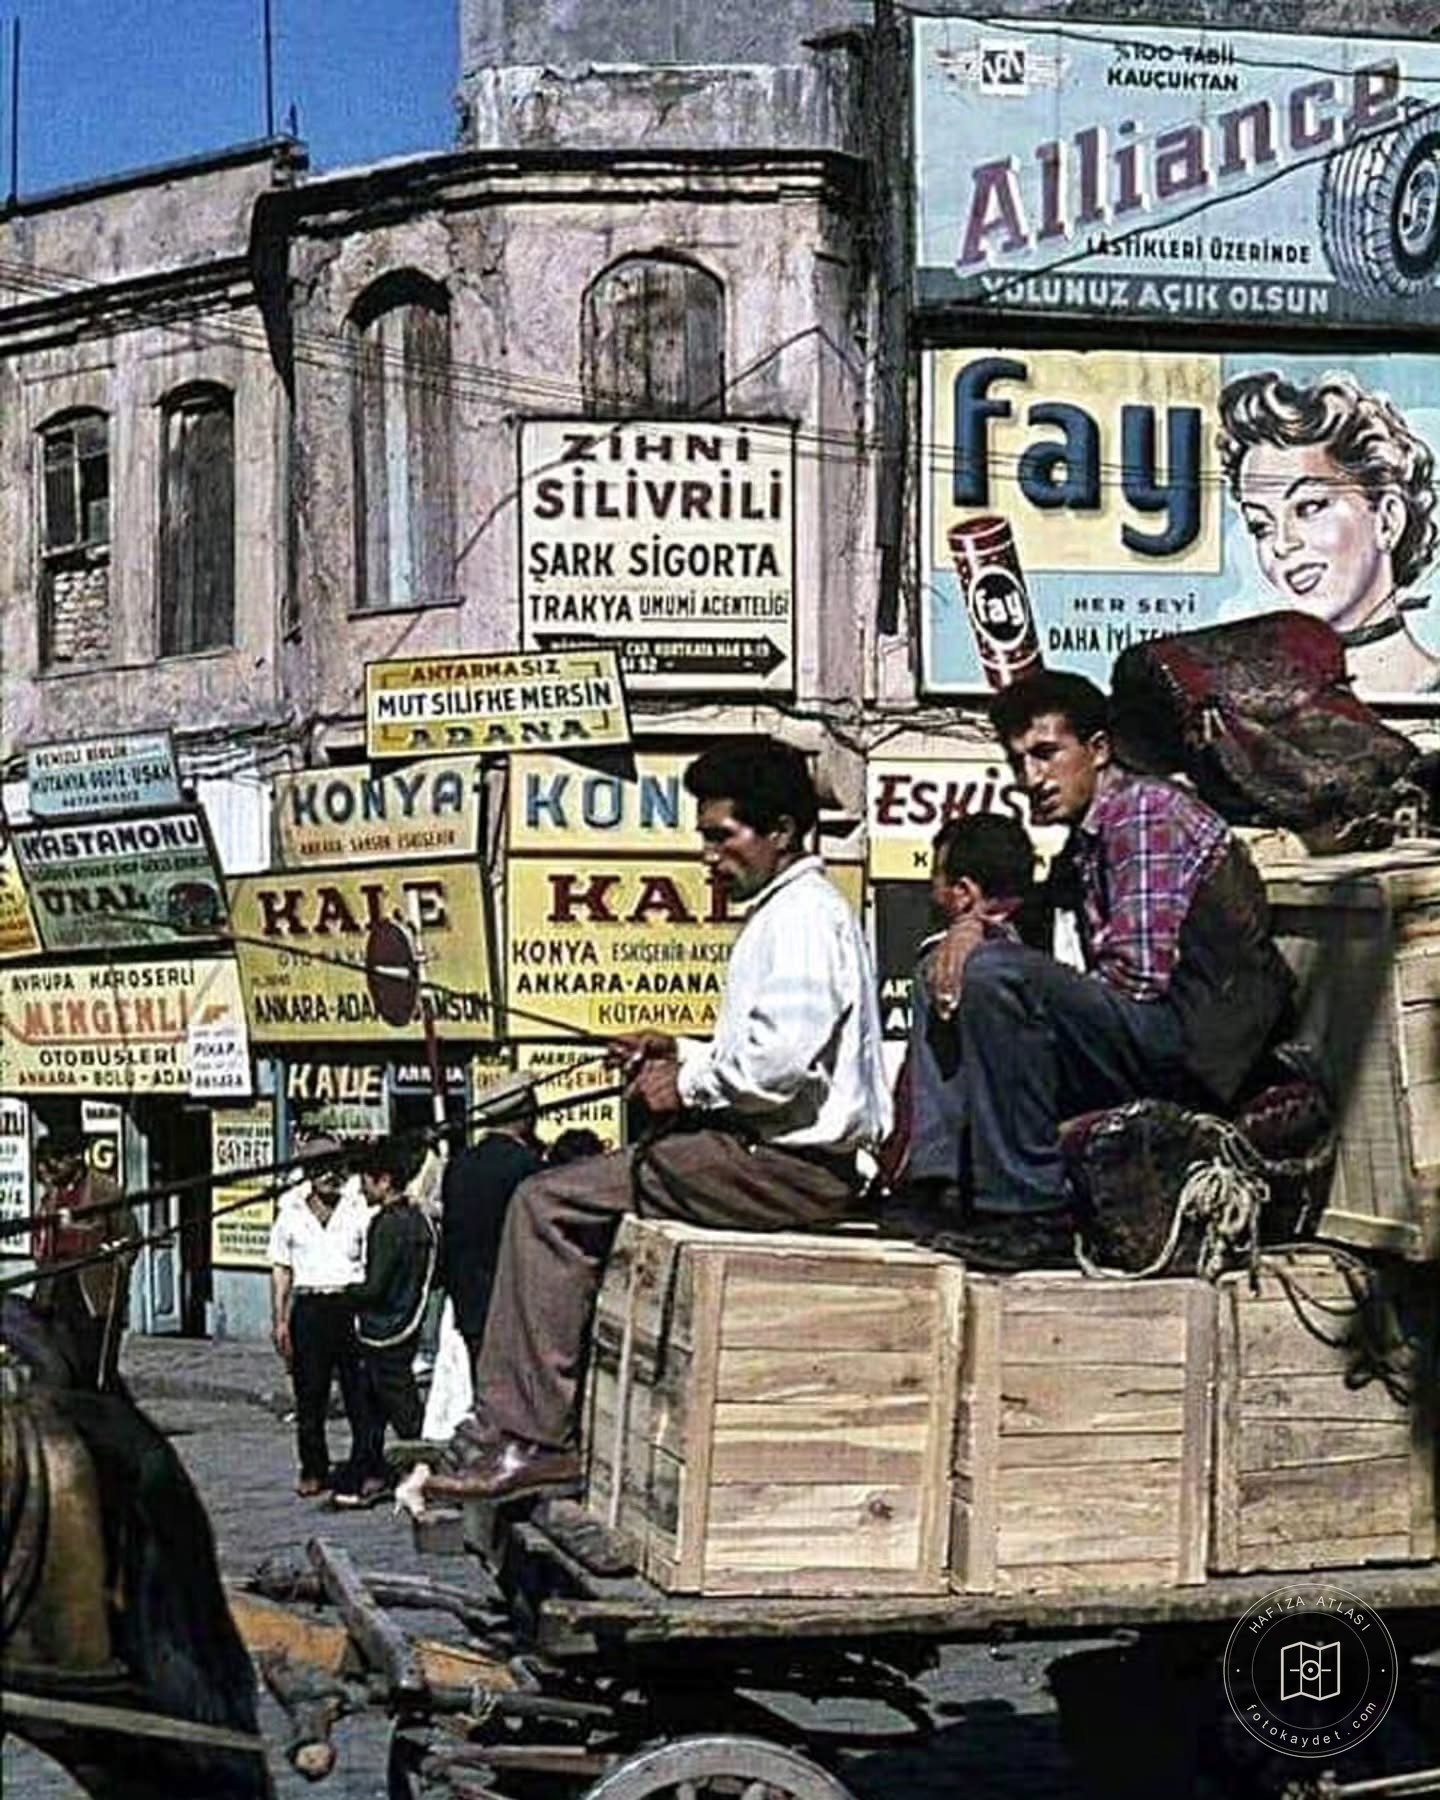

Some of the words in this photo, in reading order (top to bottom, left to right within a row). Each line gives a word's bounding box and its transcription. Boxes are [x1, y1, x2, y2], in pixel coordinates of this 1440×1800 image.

[1107, 67, 1239, 92] KAUÇUKTAN
[955, 56, 1402, 277] Alliance
[1211, 236, 1311, 264] ÜZERİNDE
[1137, 280, 1218, 311] AÇIK
[1229, 286, 1330, 313] OLSUN
[561, 425, 750, 462] ZİHNİ
[953, 356, 1203, 558] fay
[533, 466, 782, 520] SİLİVRİLİ
[528, 541, 615, 583] ŞARK
[627, 534, 780, 578] SİGORTA
[528, 594, 633, 622] TRAKYA
[975, 588, 1025, 626] fay
[1074, 598, 1124, 612] HER
[1049, 625, 1100, 652] DAHA
[377, 693, 429, 718] MUT
[408, 718, 591, 750] ADANA
[293, 769, 464, 826] KONYA
[526, 773, 680, 829] KON
[22, 817, 200, 862] KASTAMONU
[257, 881, 450, 937] KALE
[547, 873, 748, 924] KAL
[512, 939, 599, 966] KONYA
[11, 971, 76, 993] AVRUPA
[598, 1002, 696, 1025] KÜTAHYA
[18, 1071, 76, 1087] ANKARA
[287, 1063, 382, 1099] KALE
